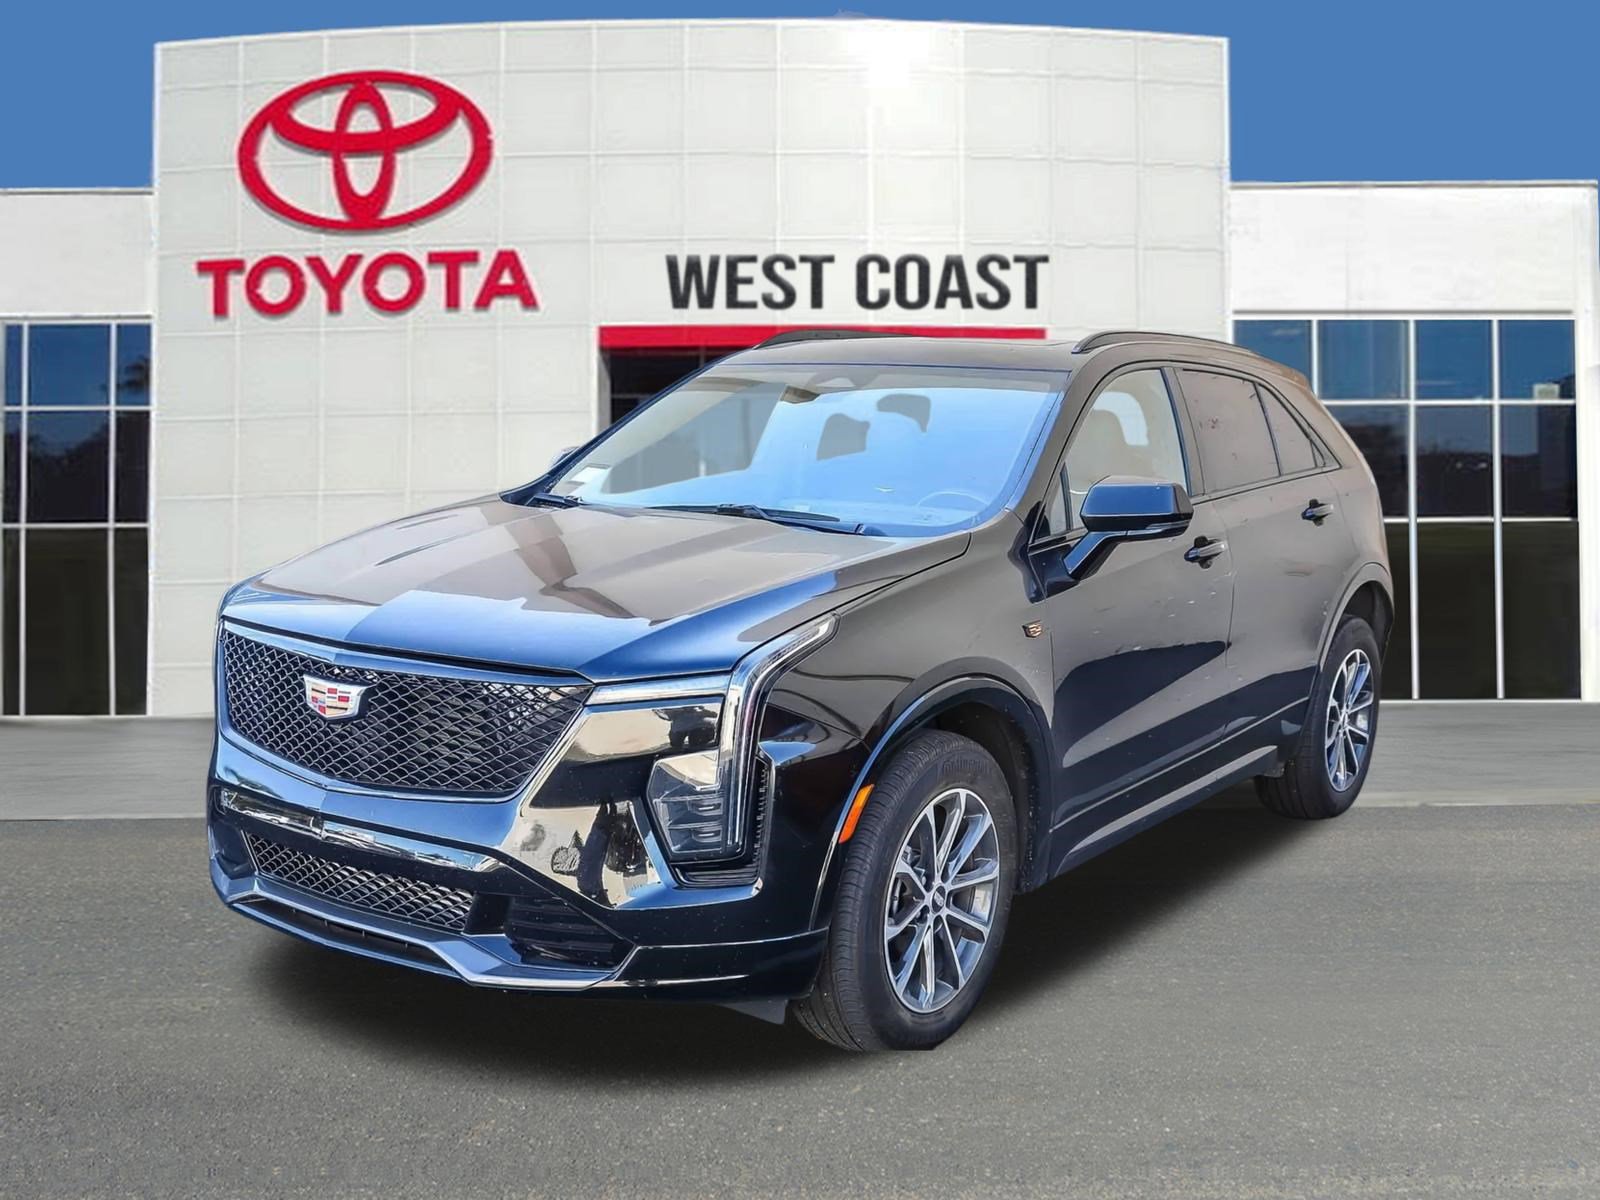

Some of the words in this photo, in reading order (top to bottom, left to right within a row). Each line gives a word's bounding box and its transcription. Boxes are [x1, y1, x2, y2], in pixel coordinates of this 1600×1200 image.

[197, 249, 538, 317] TOYOTA
[666, 254, 835, 310] WEST
[856, 254, 1050, 310] COAST
